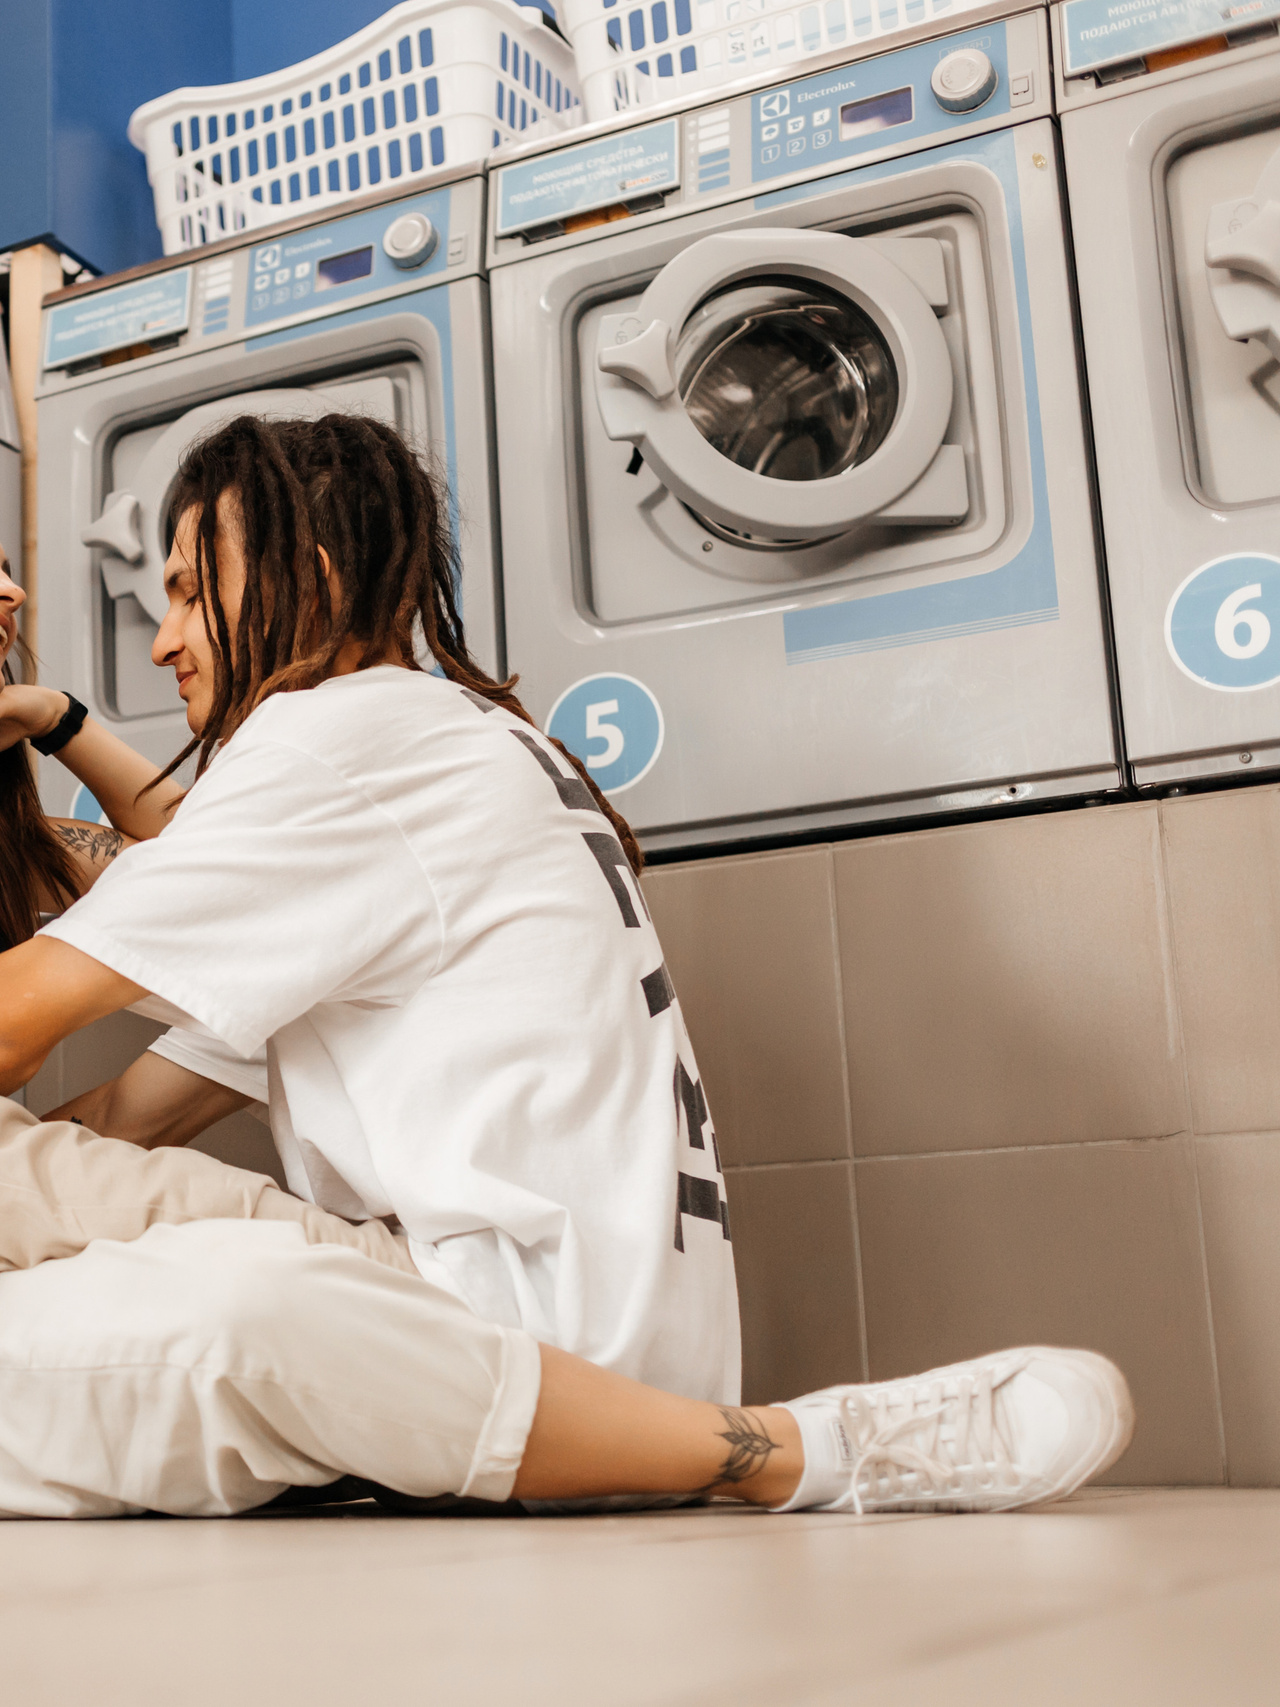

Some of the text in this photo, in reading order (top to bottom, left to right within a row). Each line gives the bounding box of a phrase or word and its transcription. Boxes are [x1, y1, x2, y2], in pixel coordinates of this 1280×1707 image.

[1080, 10, 1157, 41] ПОДАЮТСЯ
[797, 81, 856, 103] Electrolux
[766, 133, 827, 160] 1 2 3
[1214, 583, 1271, 660] 6
[585, 698, 625, 769] 5
